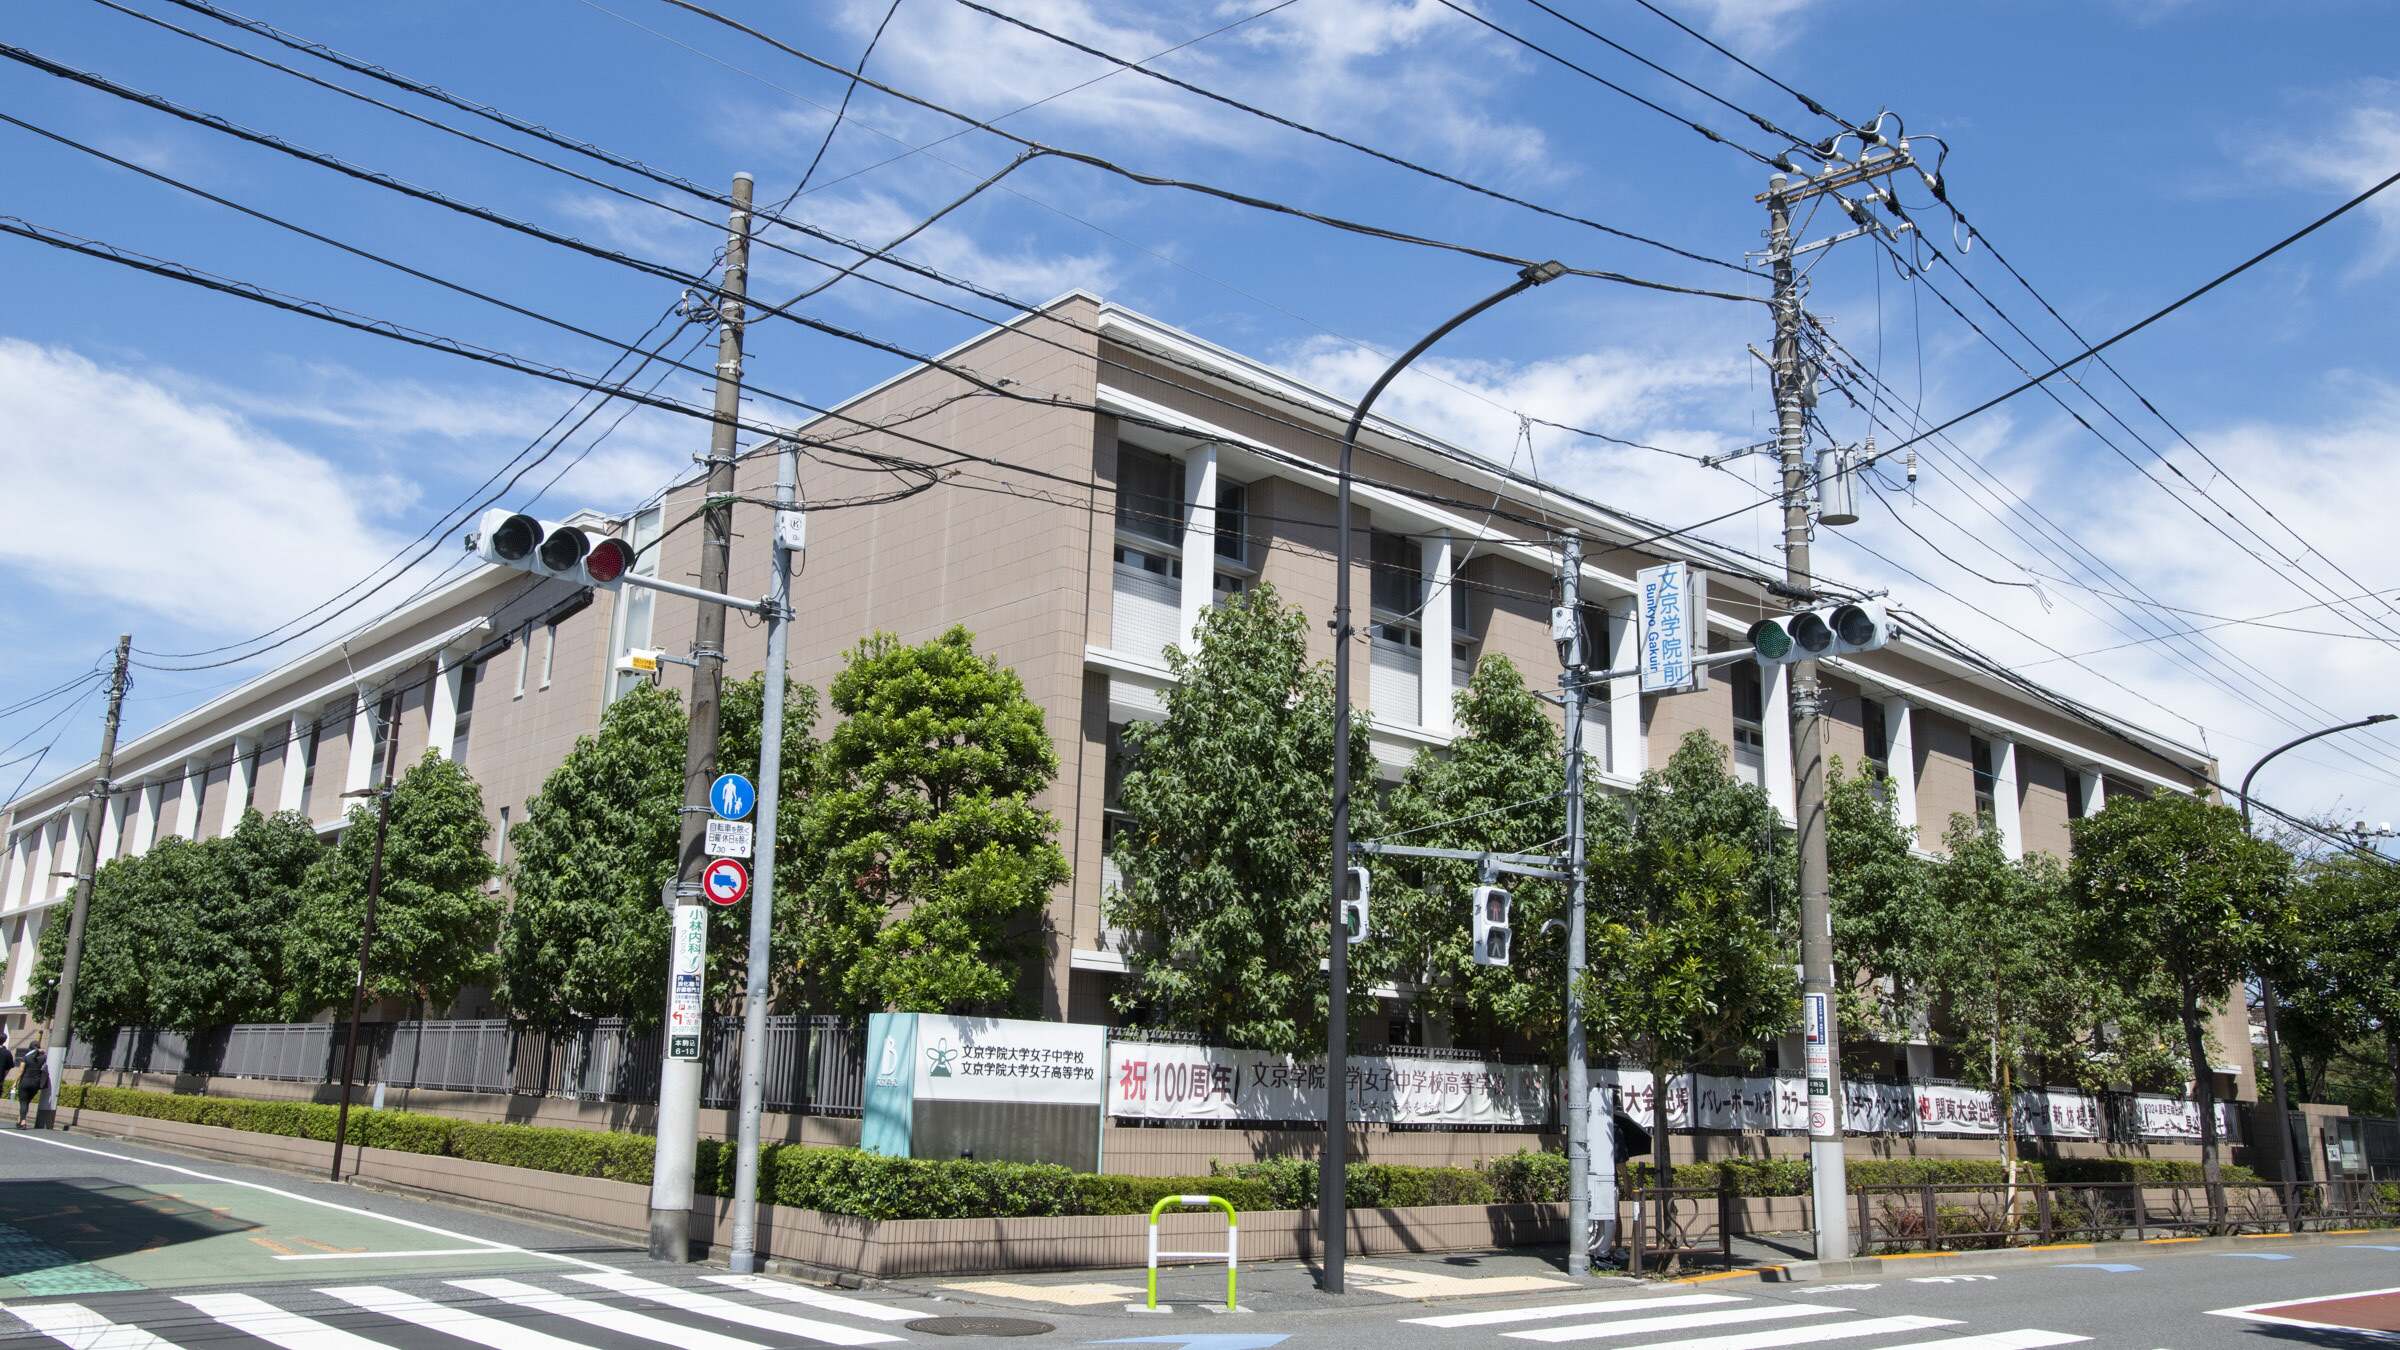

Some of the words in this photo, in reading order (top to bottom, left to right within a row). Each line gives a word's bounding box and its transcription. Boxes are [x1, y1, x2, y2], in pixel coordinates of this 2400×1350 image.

[1646, 583, 1657, 627] Bunkyo
[1658, 571, 1683, 683] 文京学院前
[1648, 632, 1659, 673] Gakuin
[688, 909, 703, 954] 小林内科
[961, 1062, 1094, 1081] 文京学院大学女子高等学校
[962, 1045, 1084, 1064] 文京学院大学女子中学校
[1119, 1059, 1147, 1100] 祝
[1153, 1062, 1232, 1103] 100周年
[1252, 1061, 1505, 1096] 文京学院学女子中学校高等学校
[1919, 1095, 1931, 1120] 祝
